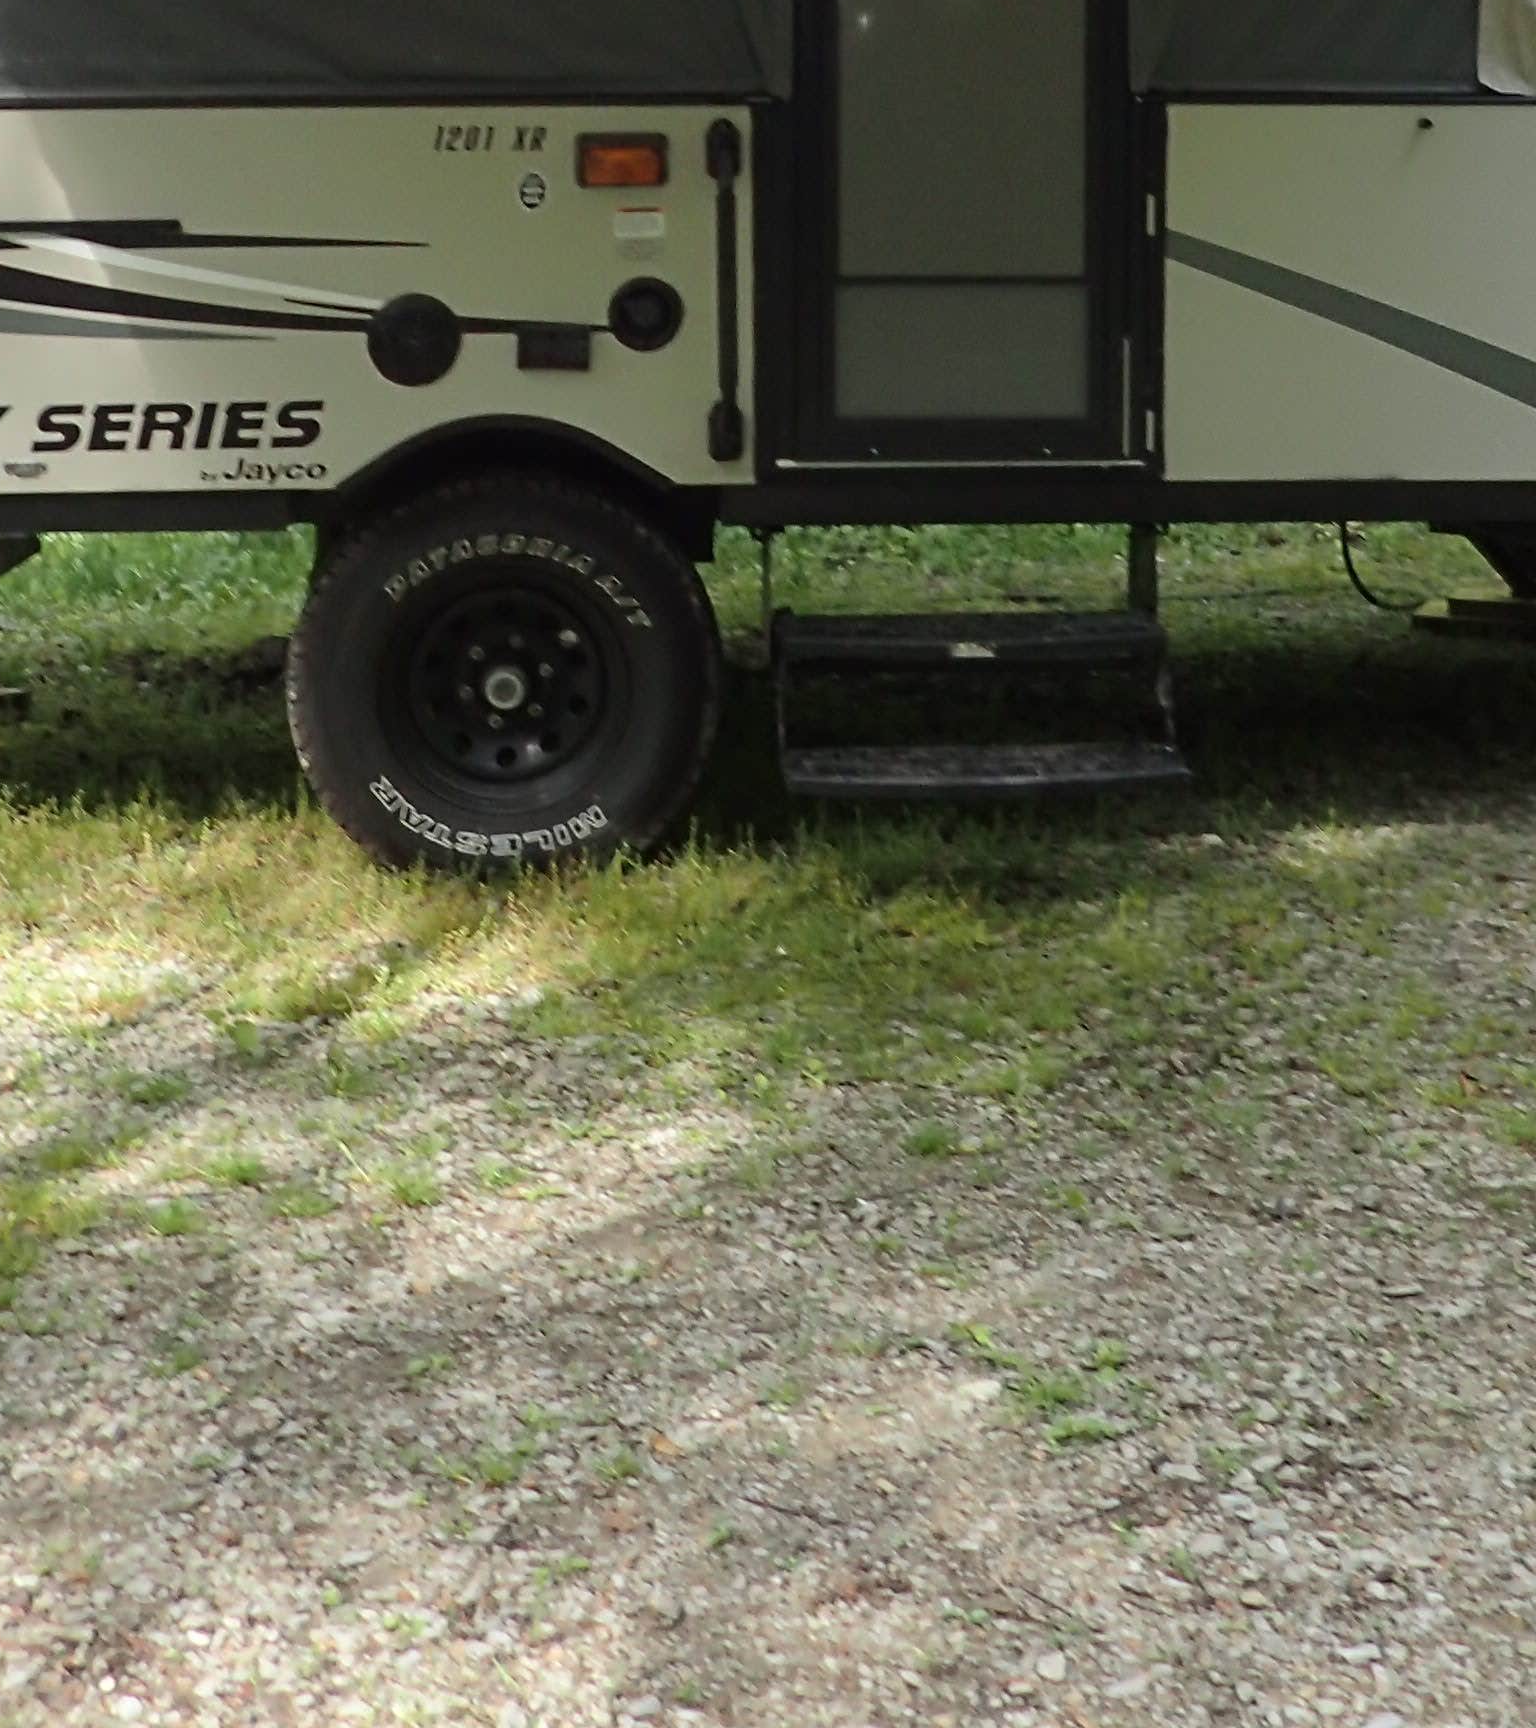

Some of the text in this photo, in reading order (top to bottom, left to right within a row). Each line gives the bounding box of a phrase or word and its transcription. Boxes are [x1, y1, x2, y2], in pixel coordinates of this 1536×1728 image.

[512, 126, 547, 151] XR
[31, 401, 324, 452] SERIES
[222, 458, 327, 484] Jayco
[369, 775, 609, 856] MILESTAR
